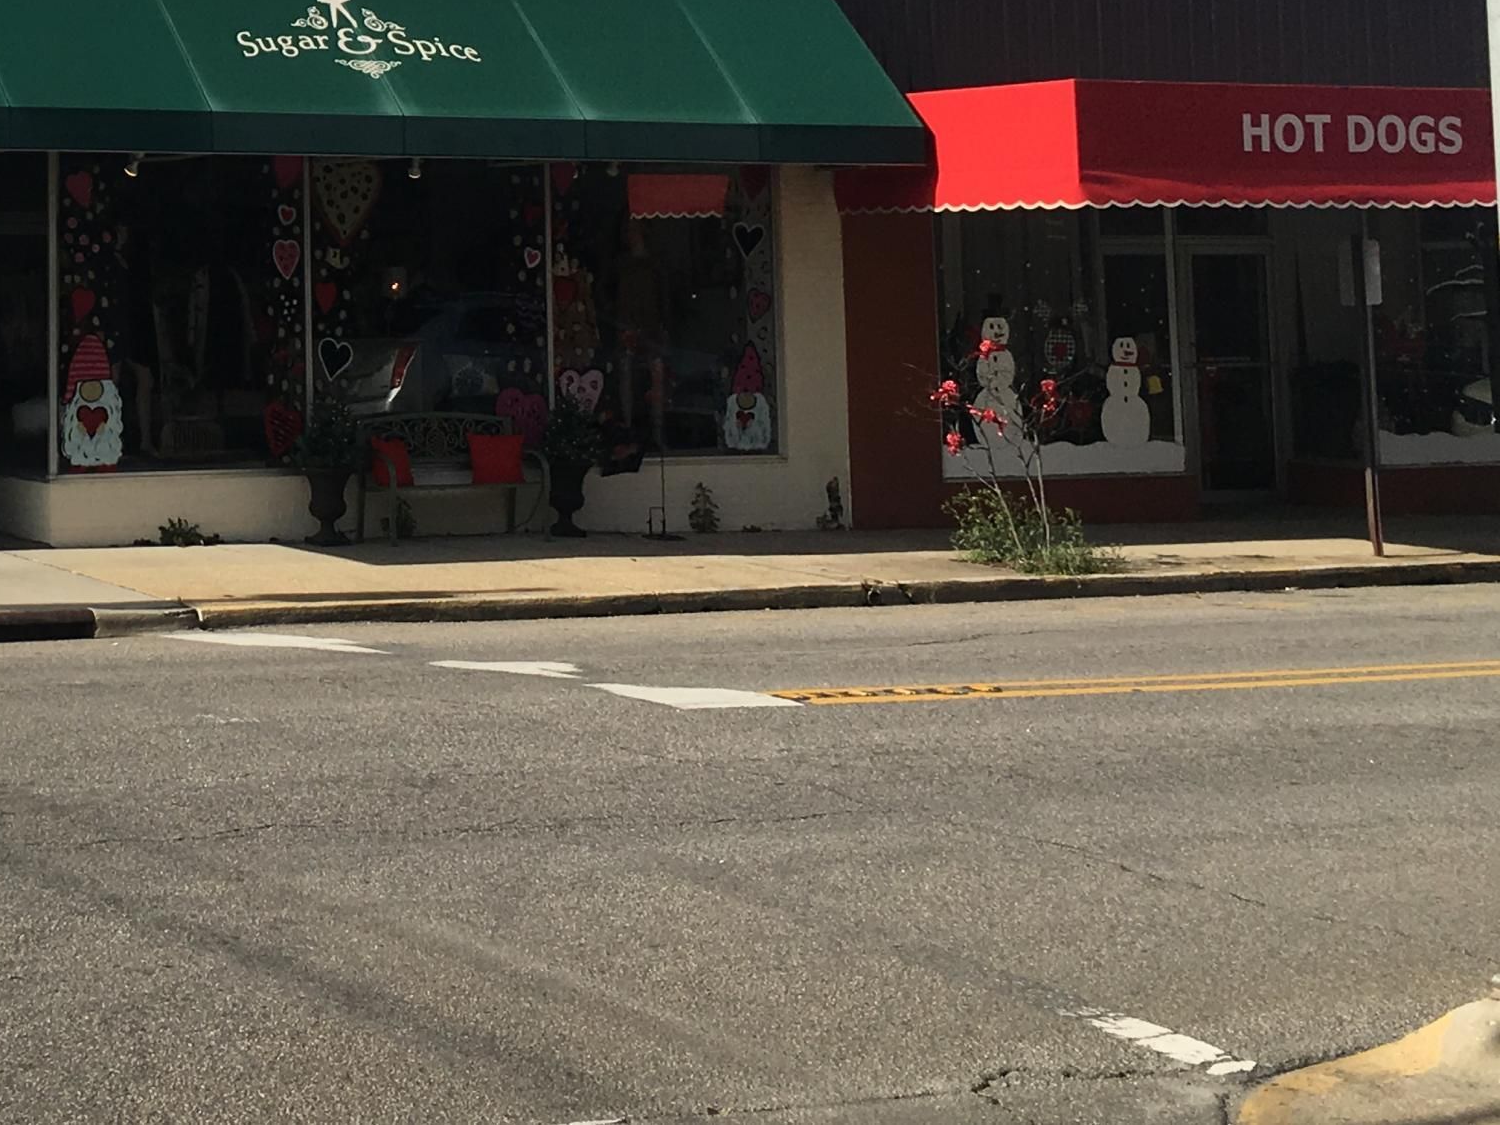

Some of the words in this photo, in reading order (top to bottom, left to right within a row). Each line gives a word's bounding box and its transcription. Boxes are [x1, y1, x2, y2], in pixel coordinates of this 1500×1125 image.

[236, 31, 329, 57] Sugar
[337, 28, 382, 55] &
[387, 29, 482, 62] Spice
[1242, 113, 1331, 153] HOT
[1347, 115, 1463, 154] DOGS
